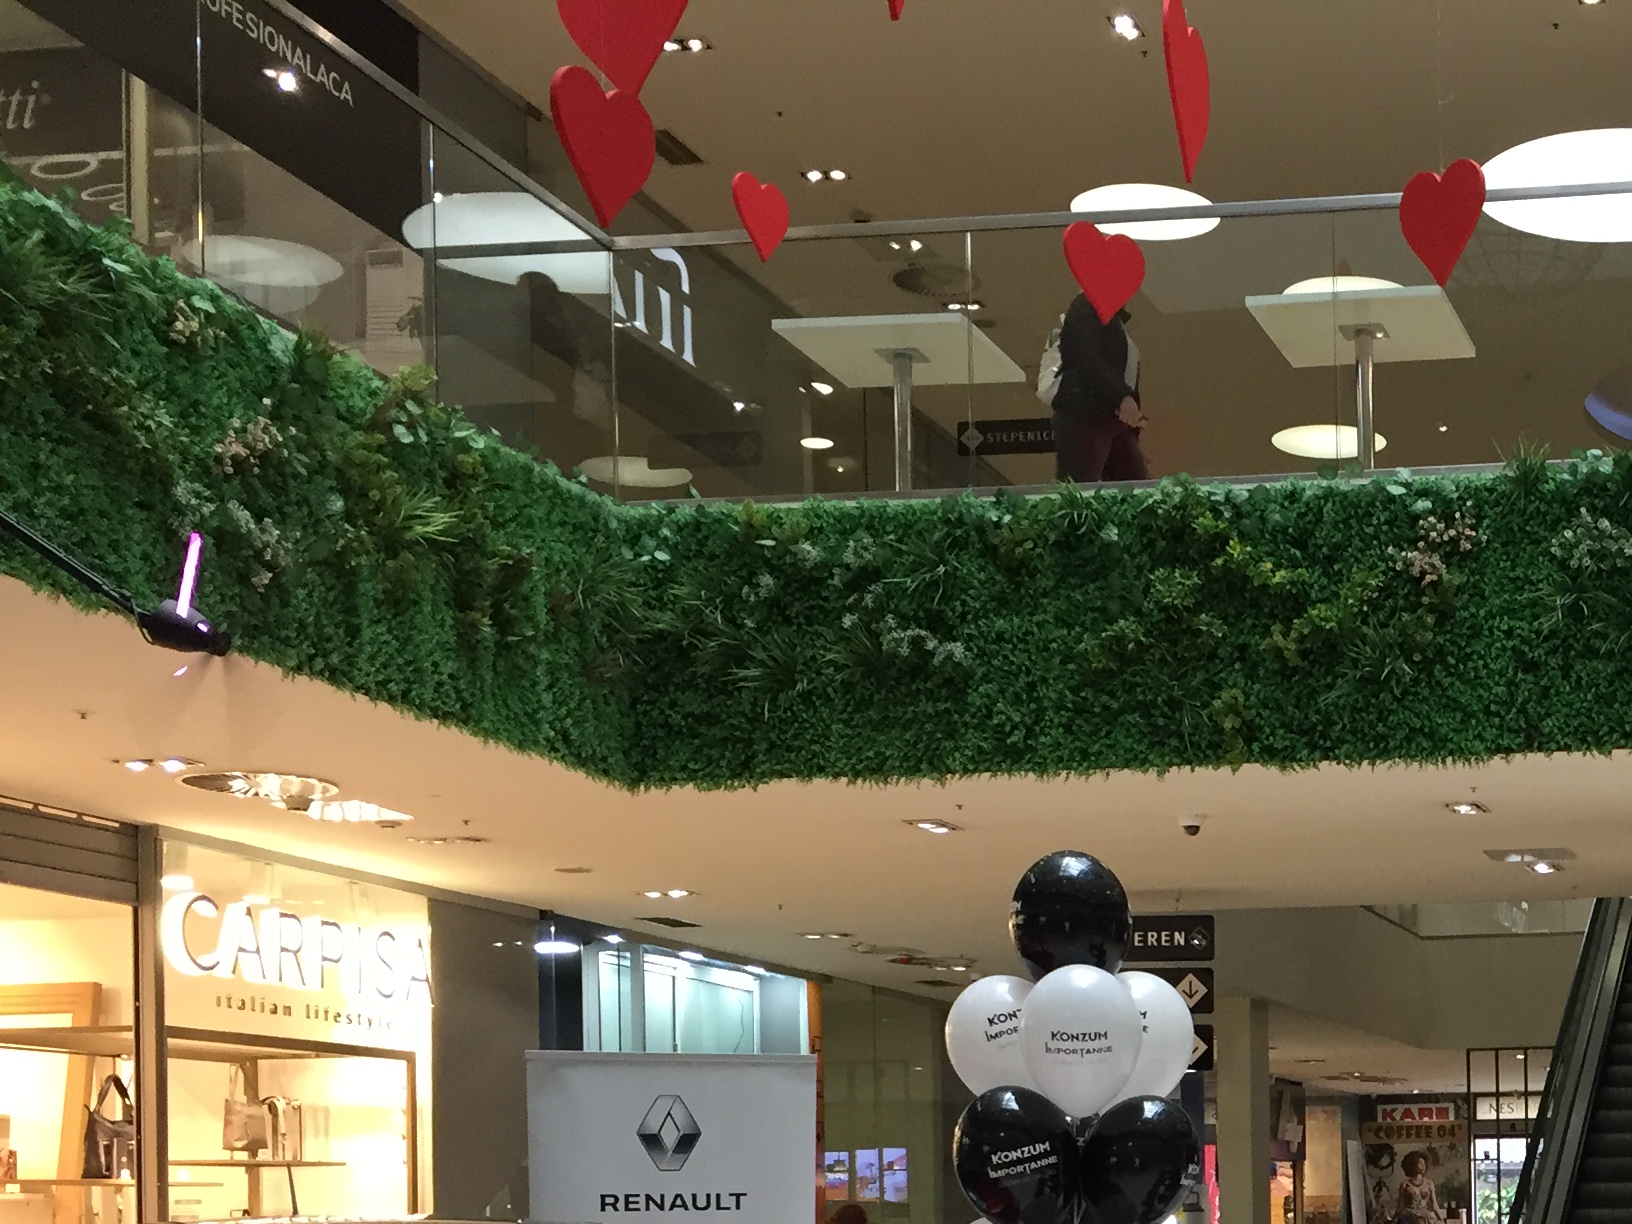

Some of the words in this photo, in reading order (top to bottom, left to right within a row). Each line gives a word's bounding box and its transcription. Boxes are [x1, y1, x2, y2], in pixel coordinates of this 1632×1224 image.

[202, 0, 355, 107] OFESIONALACA
[168, 892, 435, 1008] CARPISA
[215, 994, 293, 1018] italian
[1050, 1029, 1108, 1043] KONZUM
[990, 1140, 1051, 1166] KONZUM
[599, 1192, 748, 1213] RENAULT
